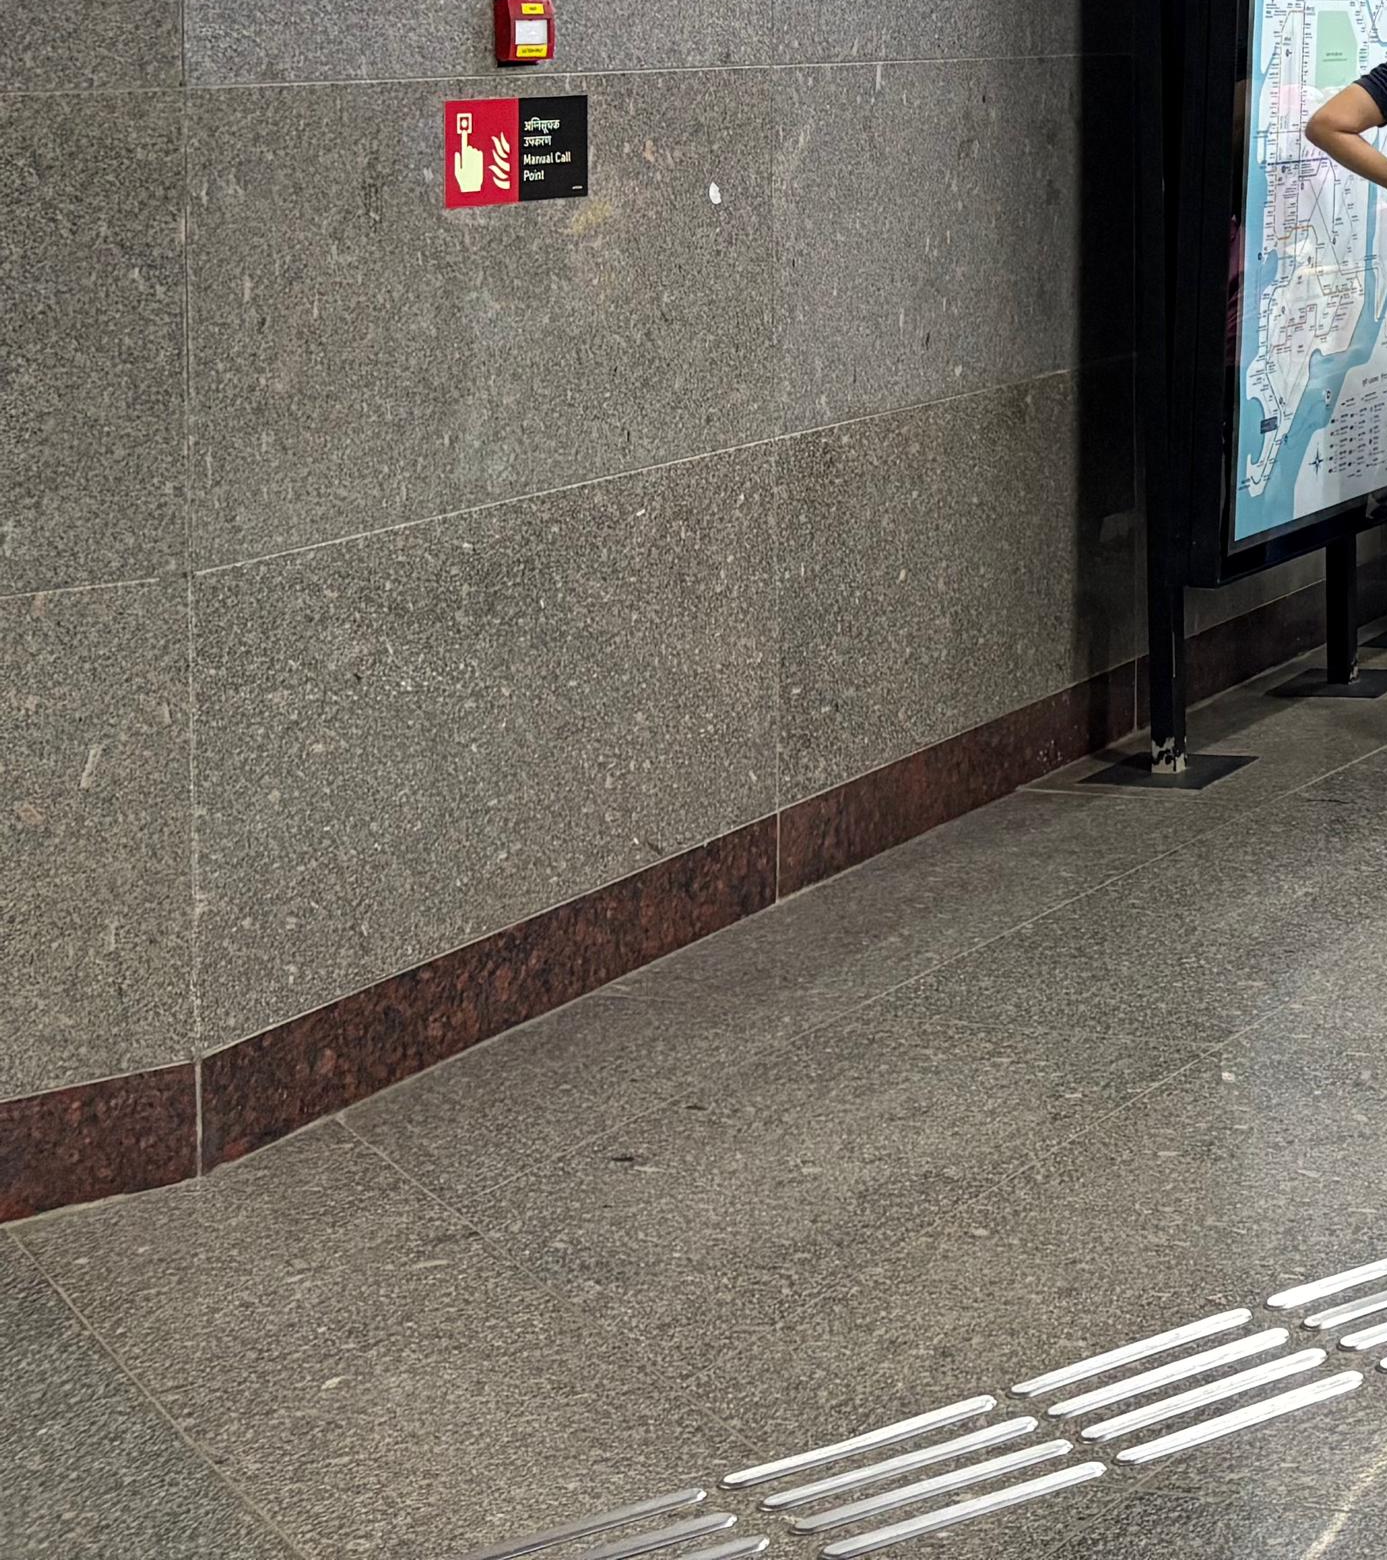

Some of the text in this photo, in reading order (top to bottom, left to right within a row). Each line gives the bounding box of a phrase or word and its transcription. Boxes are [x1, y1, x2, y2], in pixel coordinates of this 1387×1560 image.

[523, 151, 571, 165] Manual Call
[523, 169, 544, 182] Point
